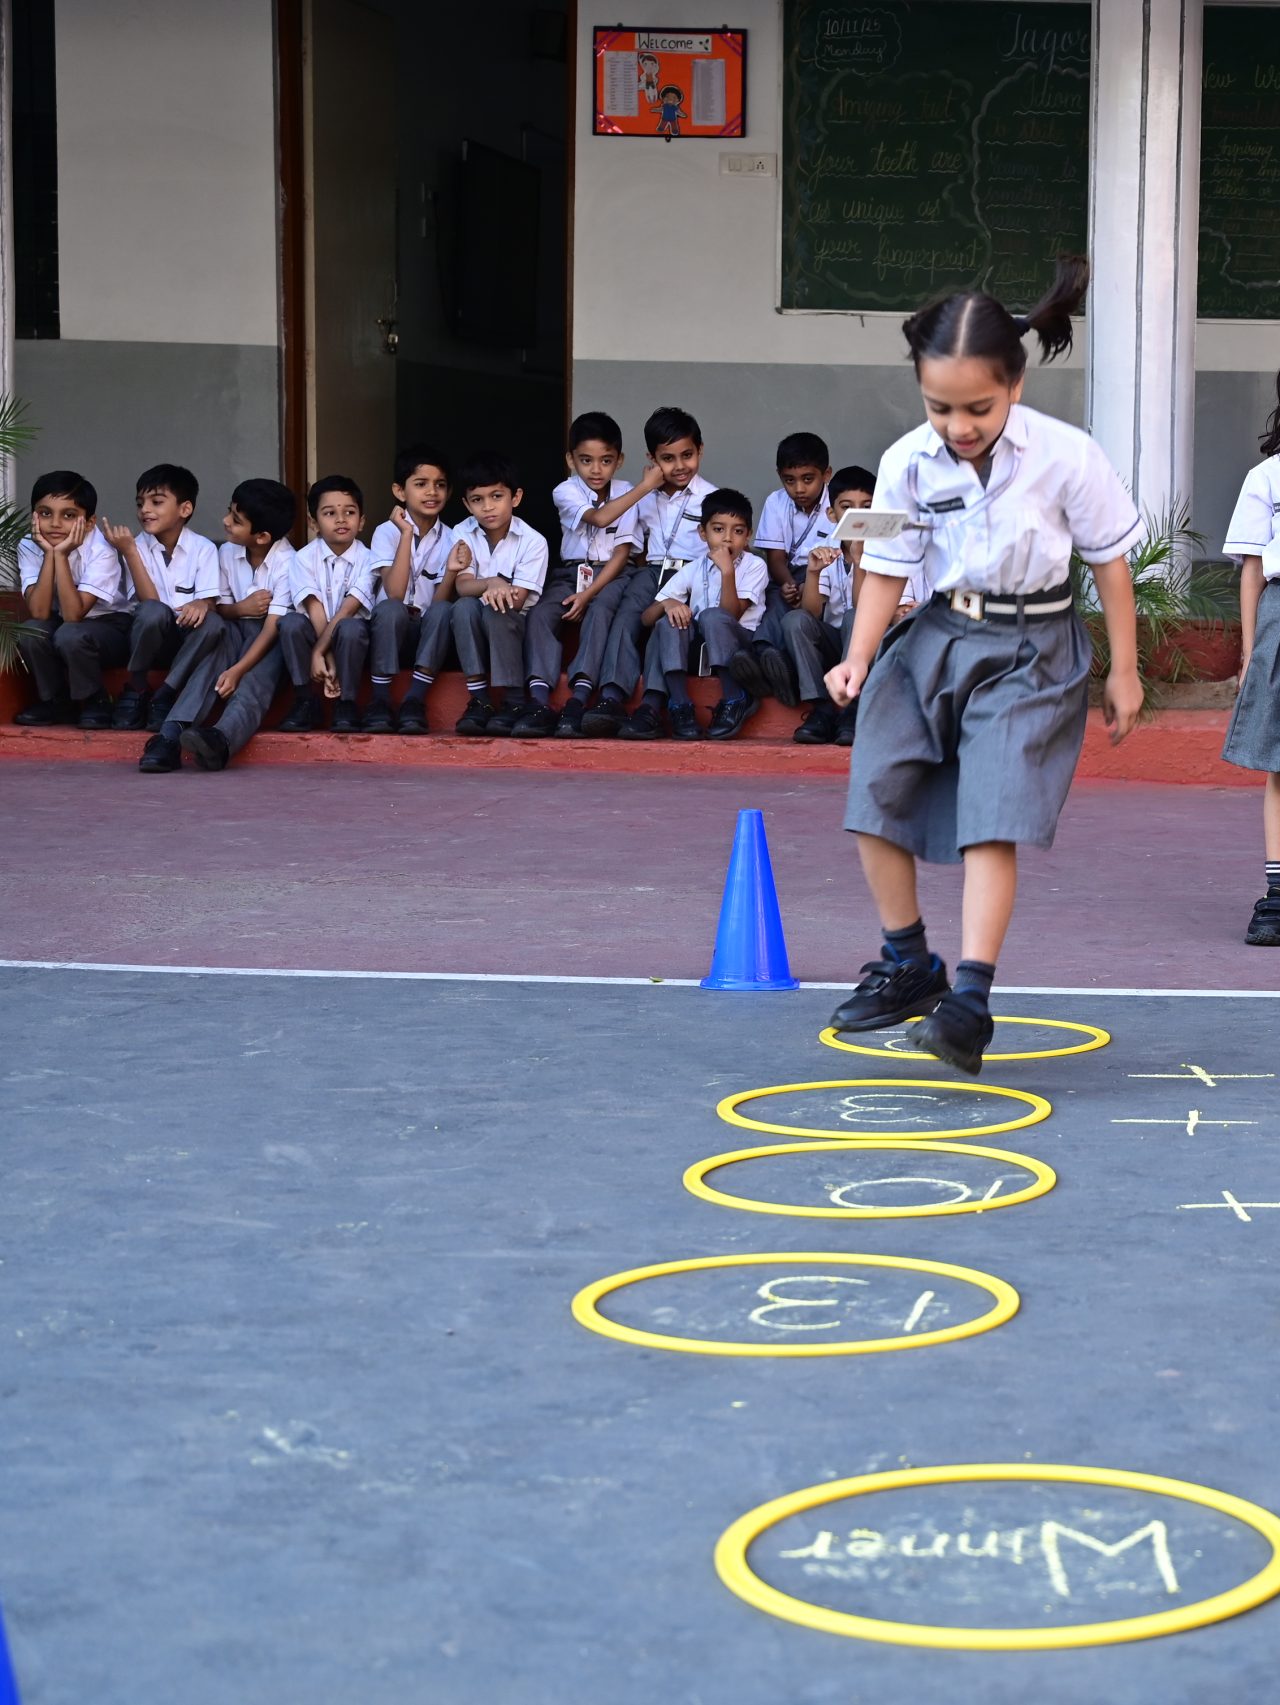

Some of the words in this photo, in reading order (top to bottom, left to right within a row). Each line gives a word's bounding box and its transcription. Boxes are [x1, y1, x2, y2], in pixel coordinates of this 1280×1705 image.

[824, 17, 881, 36] 10/11/25
[822, 40, 888, 63] Monday
[808, 143, 858, 193] Your
[871, 141, 919, 173] teeth
[931, 151, 963, 170] are
[842, 197, 905, 232] unique
[813, 239, 862, 273] your
[840, 1094, 938, 1123] 3
[830, 1177, 1002, 1213] 10
[749, 1275, 935, 1331] 13
[780, 1519, 1181, 1596] Winner
